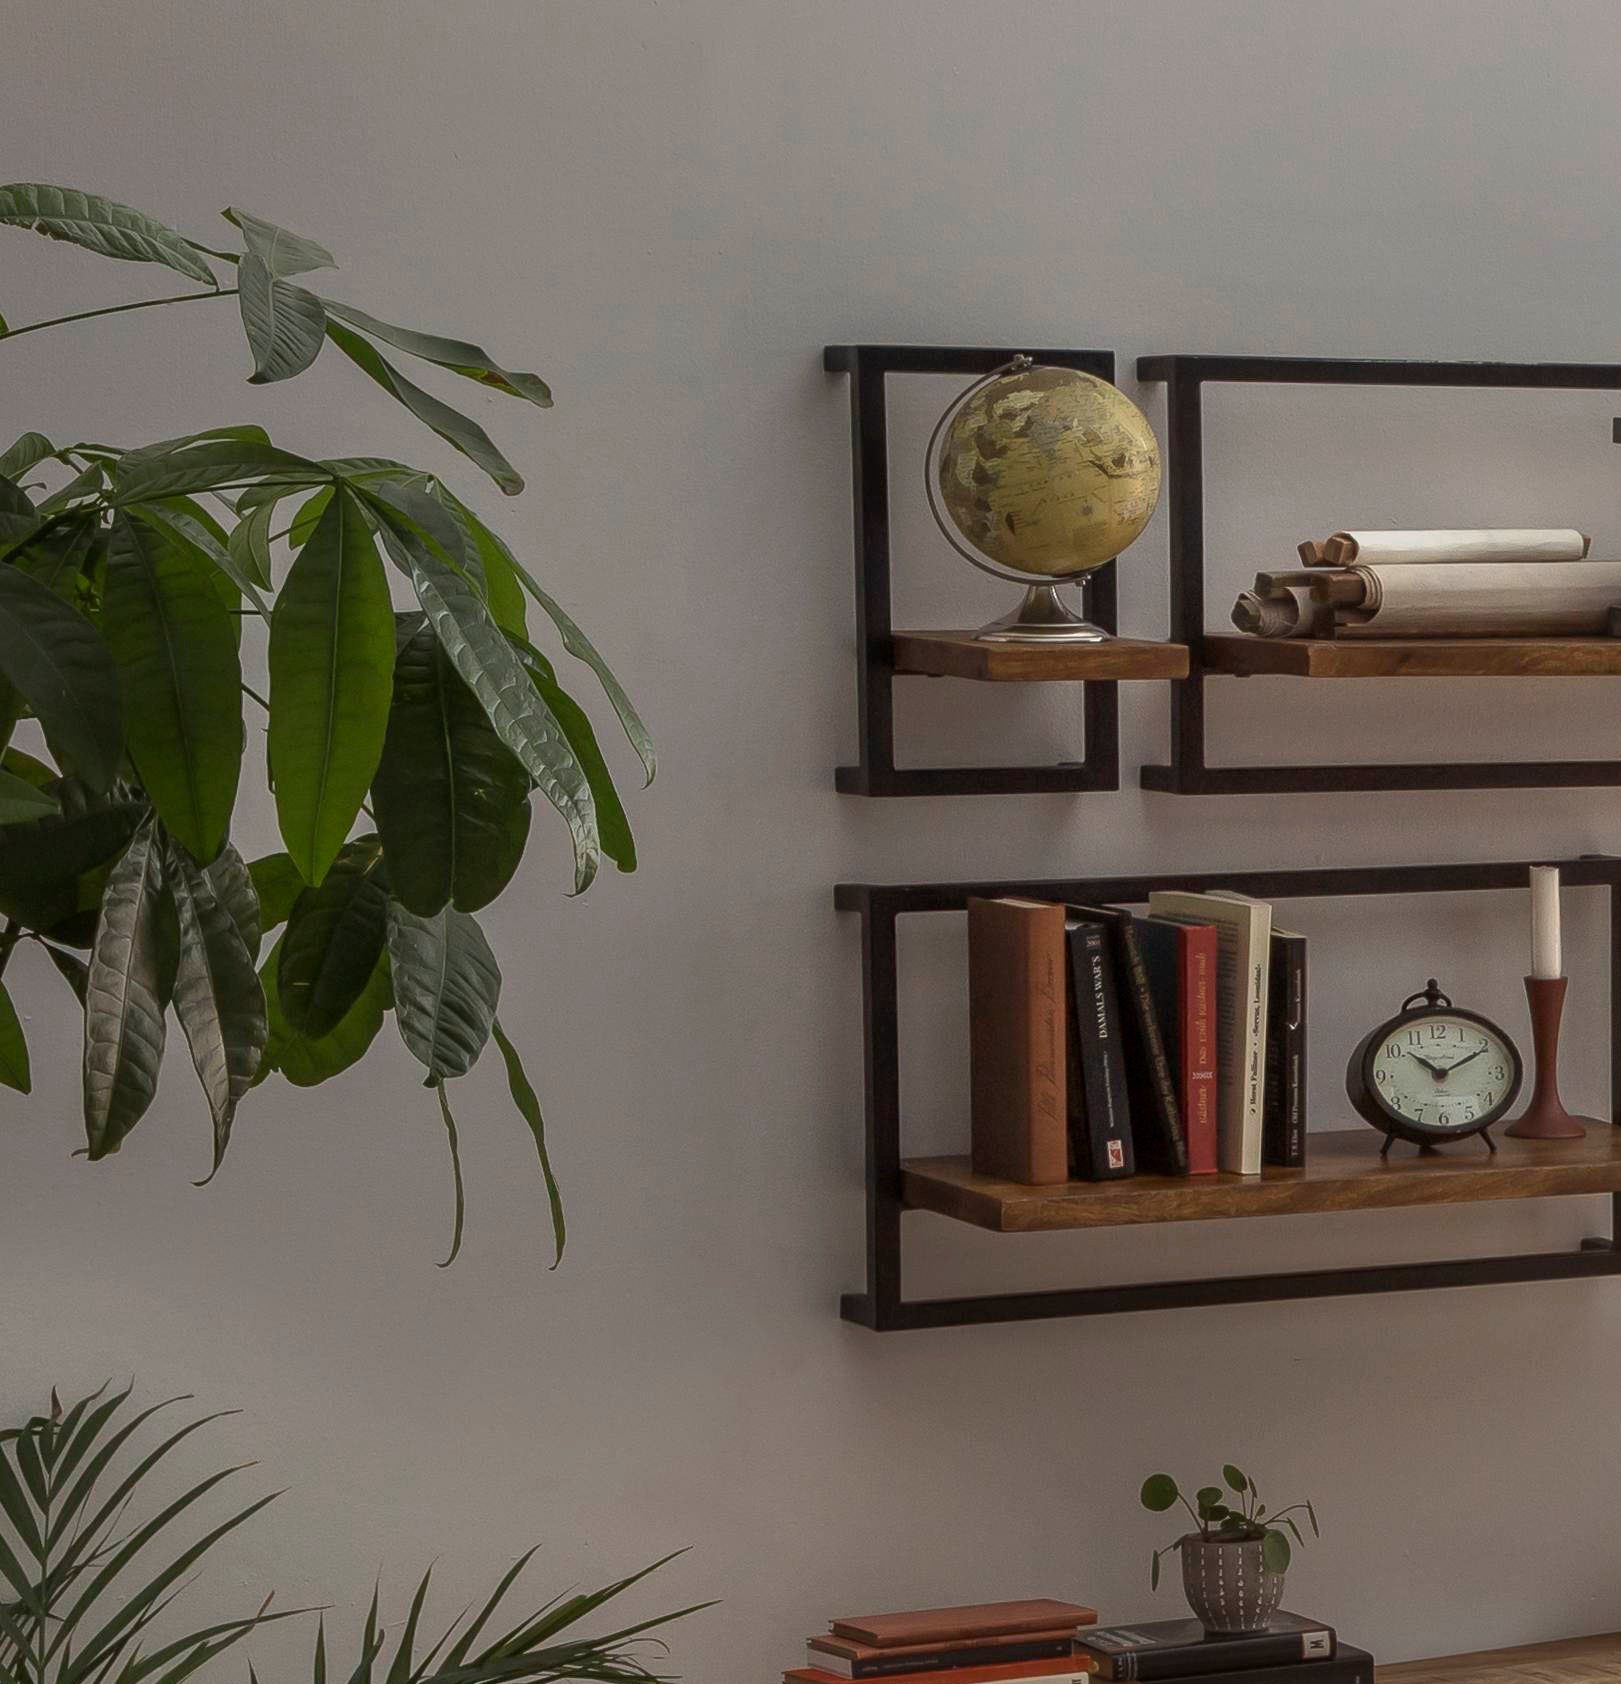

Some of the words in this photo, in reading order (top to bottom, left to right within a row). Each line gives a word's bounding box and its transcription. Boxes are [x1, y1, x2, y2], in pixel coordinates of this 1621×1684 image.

[1096, 992, 1108, 1039] DAMALS
[1407, 1030, 1421, 1046] 11
[1429, 1024, 1446, 1039] 12
[1458, 1028, 1465, 1042] 1
[1386, 1043, 1401, 1058] 10
[1478, 1039, 1488, 1052] 2
[1375, 1070, 1386, 1084] 9
[1494, 1066, 1504, 1080] 3
[1390, 1096, 1401, 1110] 8
[1483, 1092, 1493, 1106] 4
[1414, 1108, 1424, 1123] 7
[1438, 1111, 1449, 1125] 6
[1464, 1106, 1475, 1120] 5
